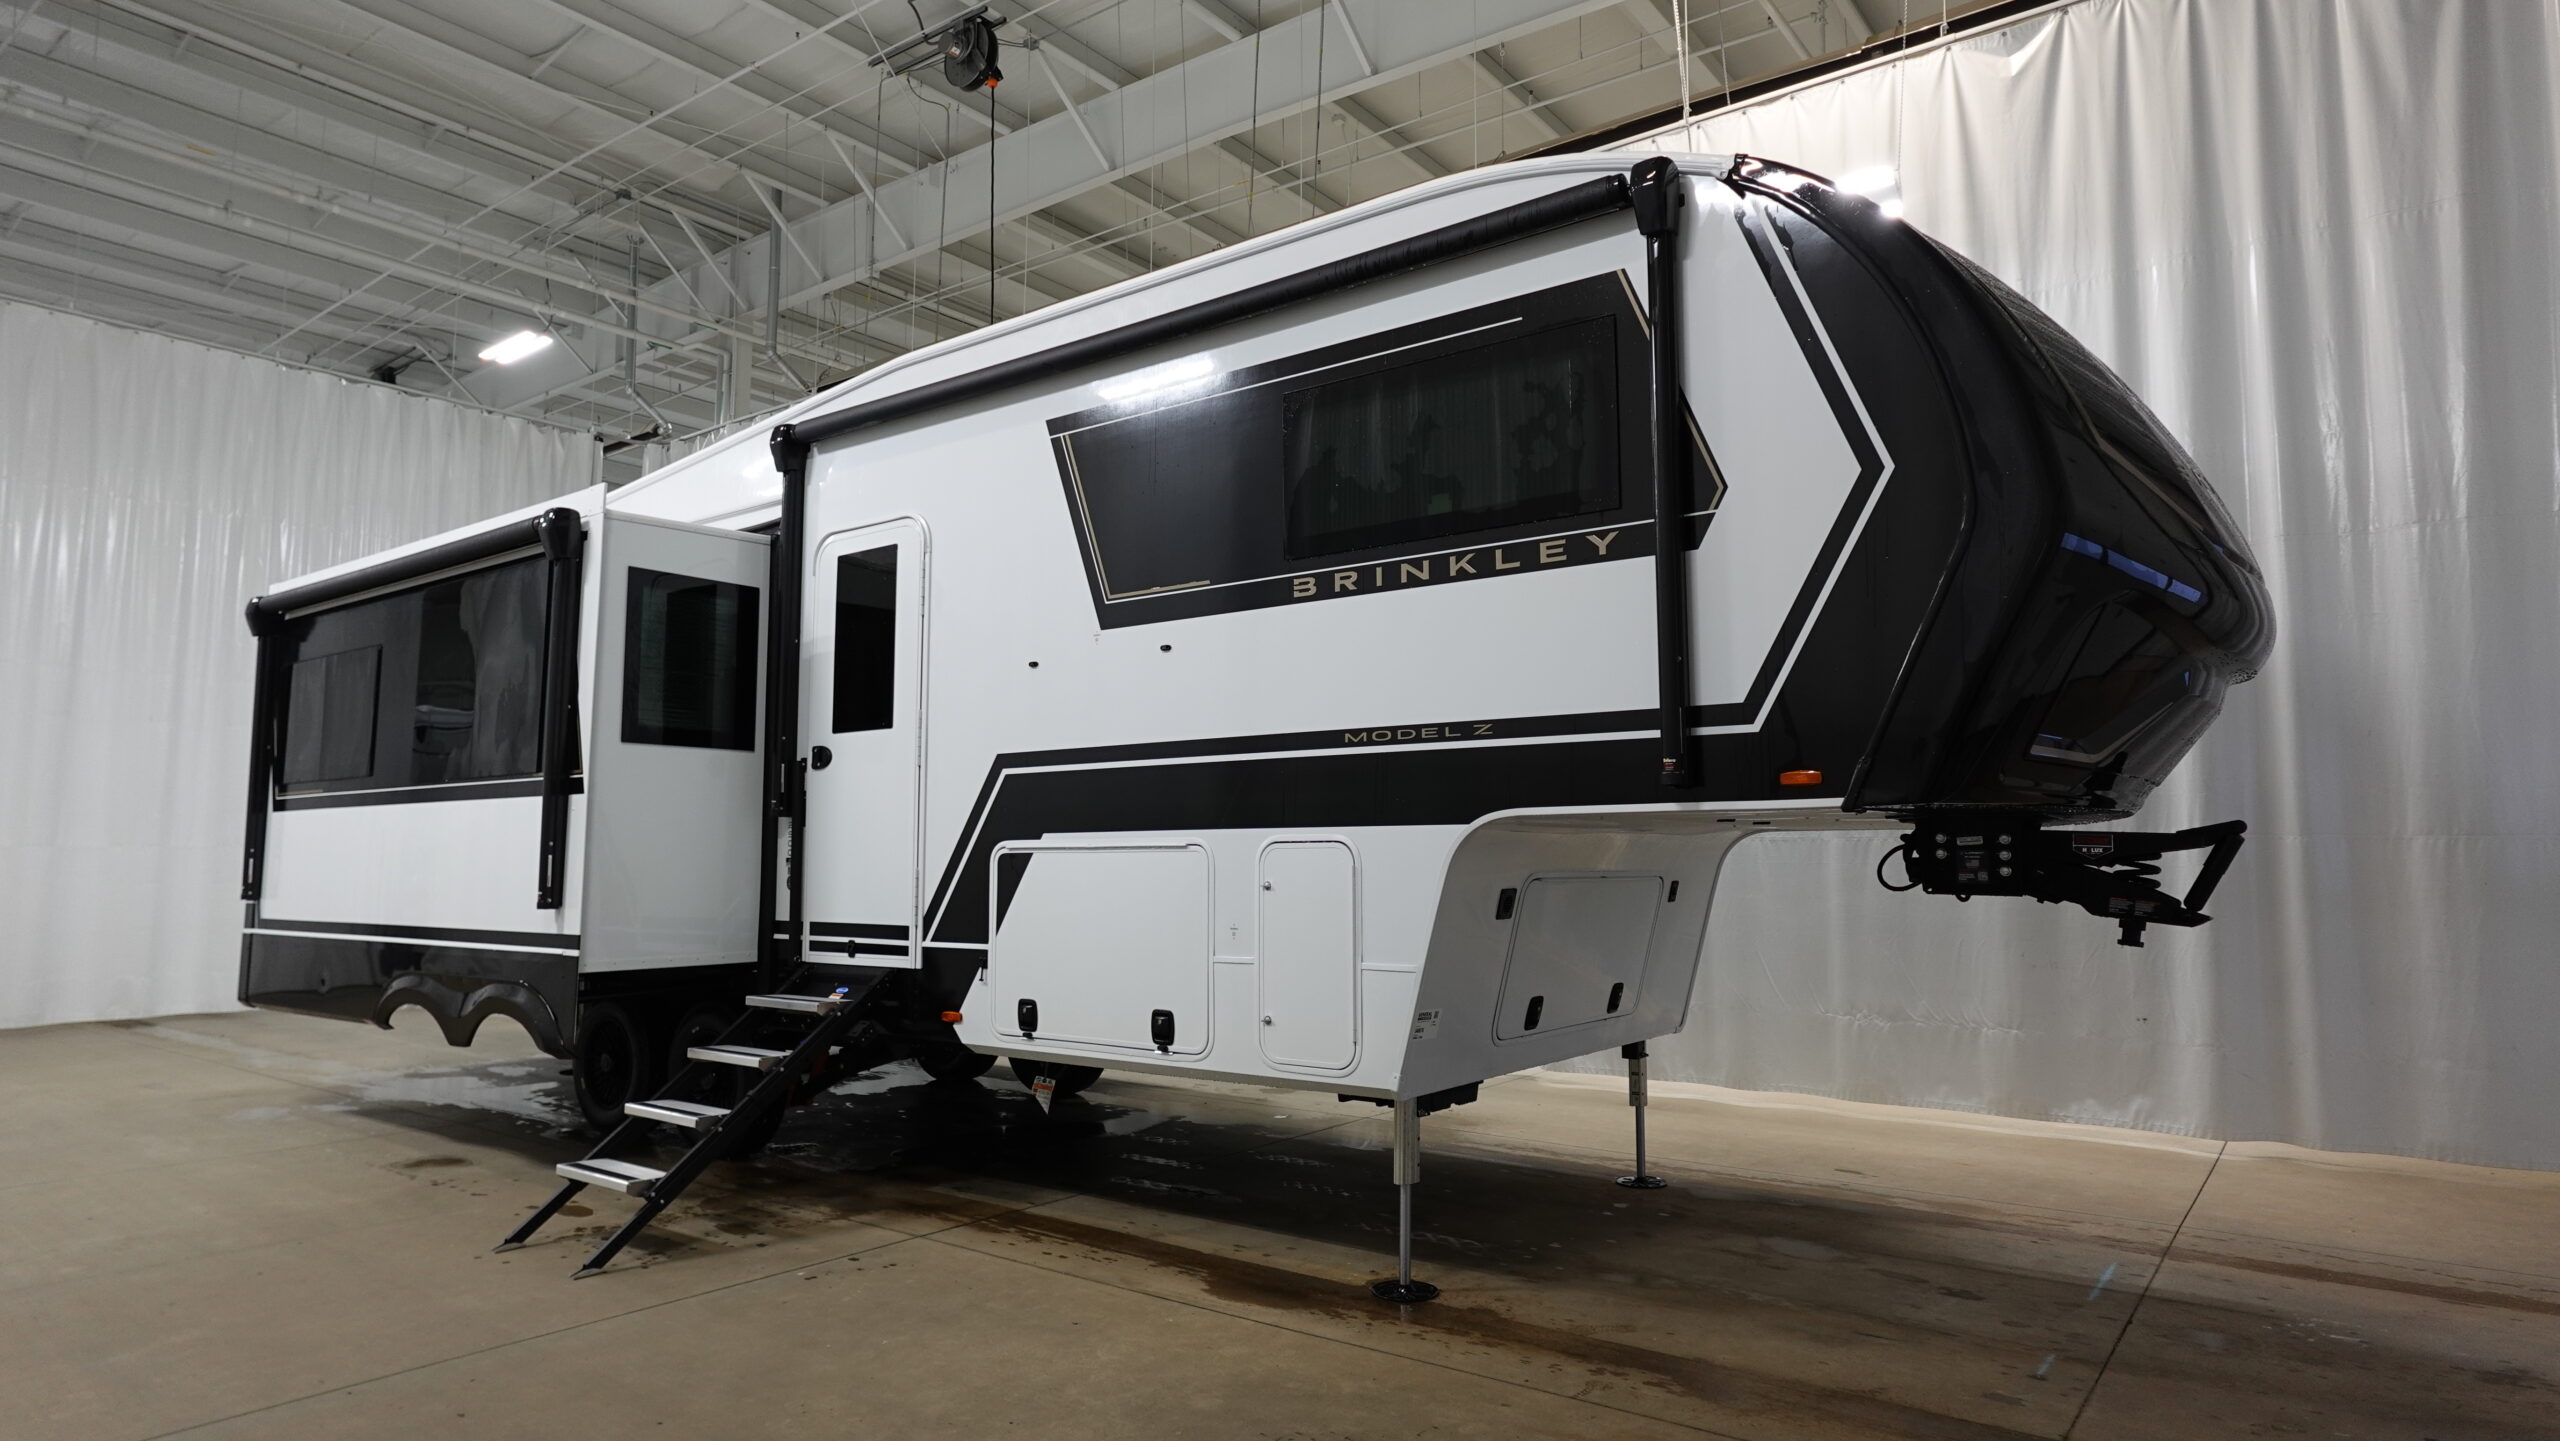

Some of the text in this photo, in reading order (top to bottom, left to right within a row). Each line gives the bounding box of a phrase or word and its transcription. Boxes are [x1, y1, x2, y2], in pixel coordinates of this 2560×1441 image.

[1293, 530, 1619, 598] BRINKLEY
[1344, 723, 1494, 743] MODEL Z
